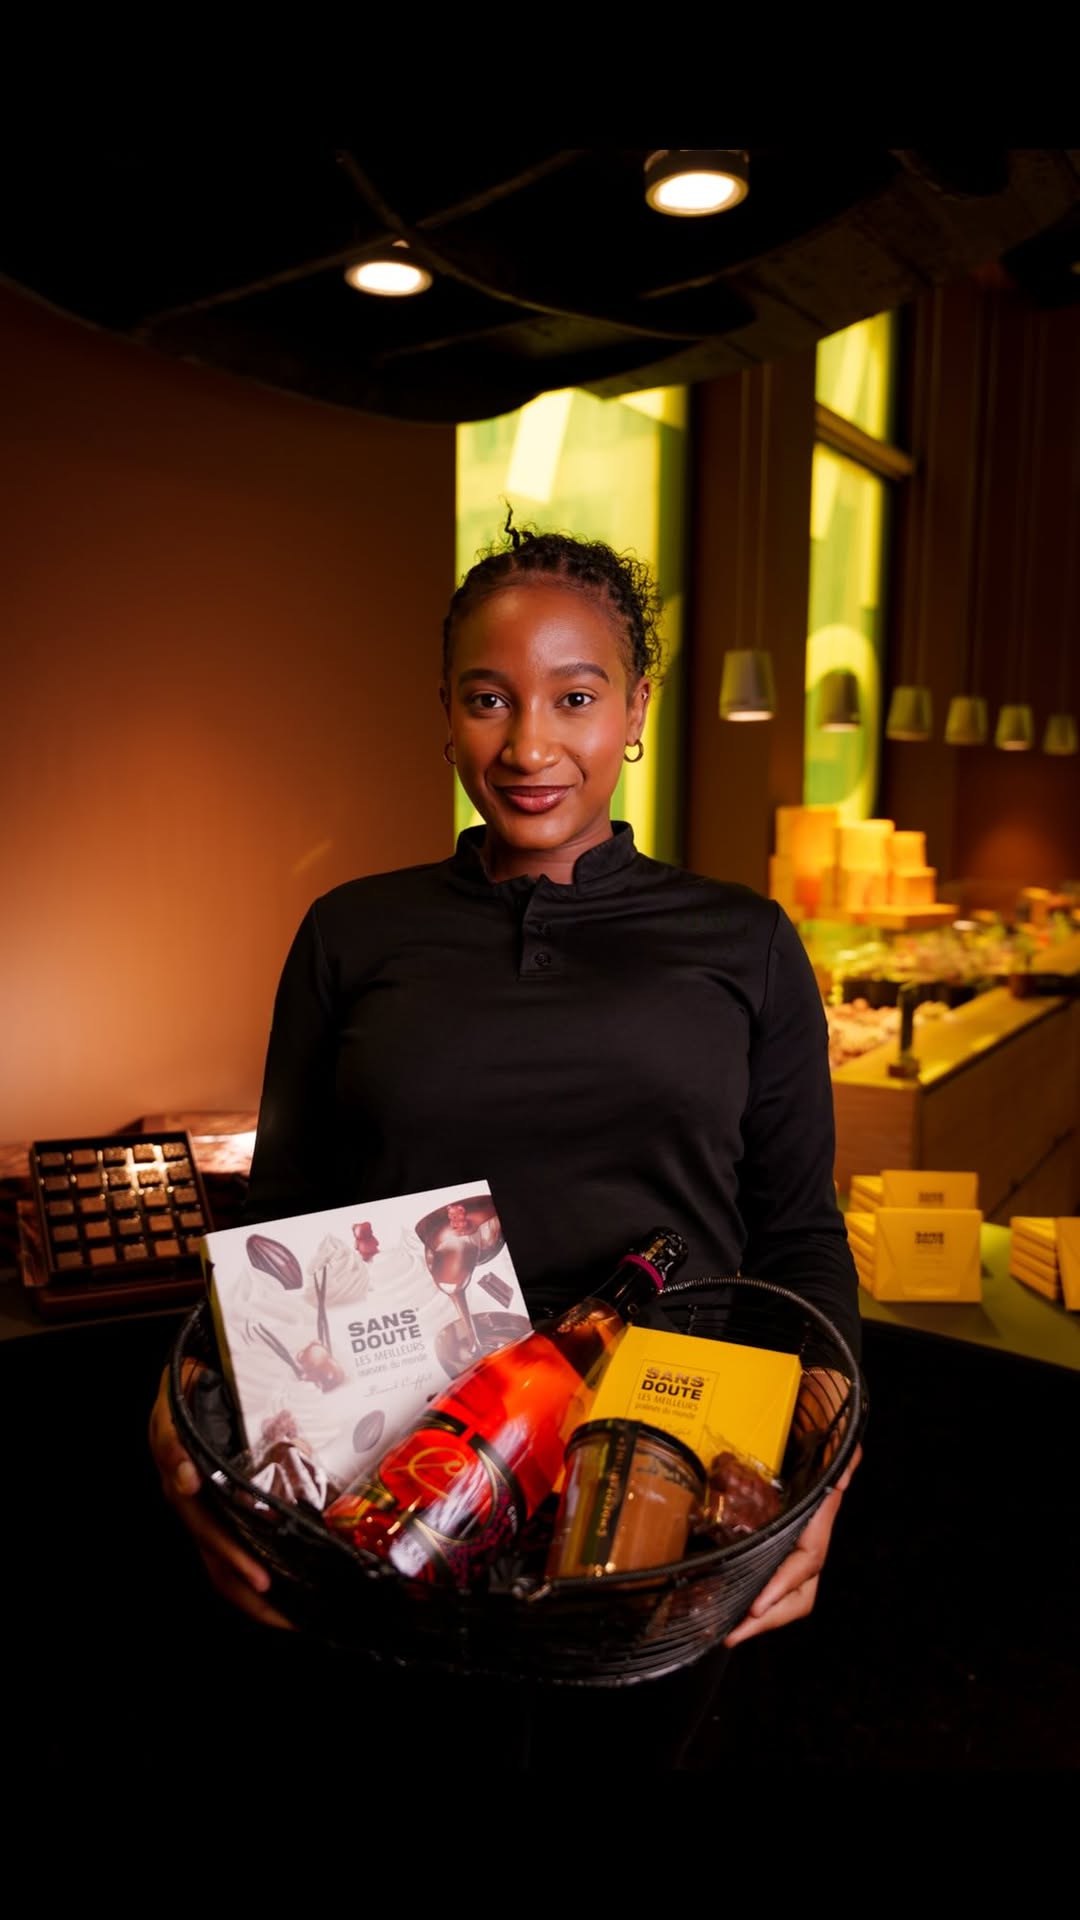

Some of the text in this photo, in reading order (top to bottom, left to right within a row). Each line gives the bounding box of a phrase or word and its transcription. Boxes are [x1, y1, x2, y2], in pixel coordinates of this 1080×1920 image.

[348, 1308, 417, 1337] SANS
[351, 1324, 422, 1354] DOUTE
[355, 1342, 425, 1368] LES MEILLEURS
[645, 1366, 705, 1388] SANS
[637, 1392, 699, 1411] LES MEILLEURS
[641, 1379, 703, 1401] DOUTE
